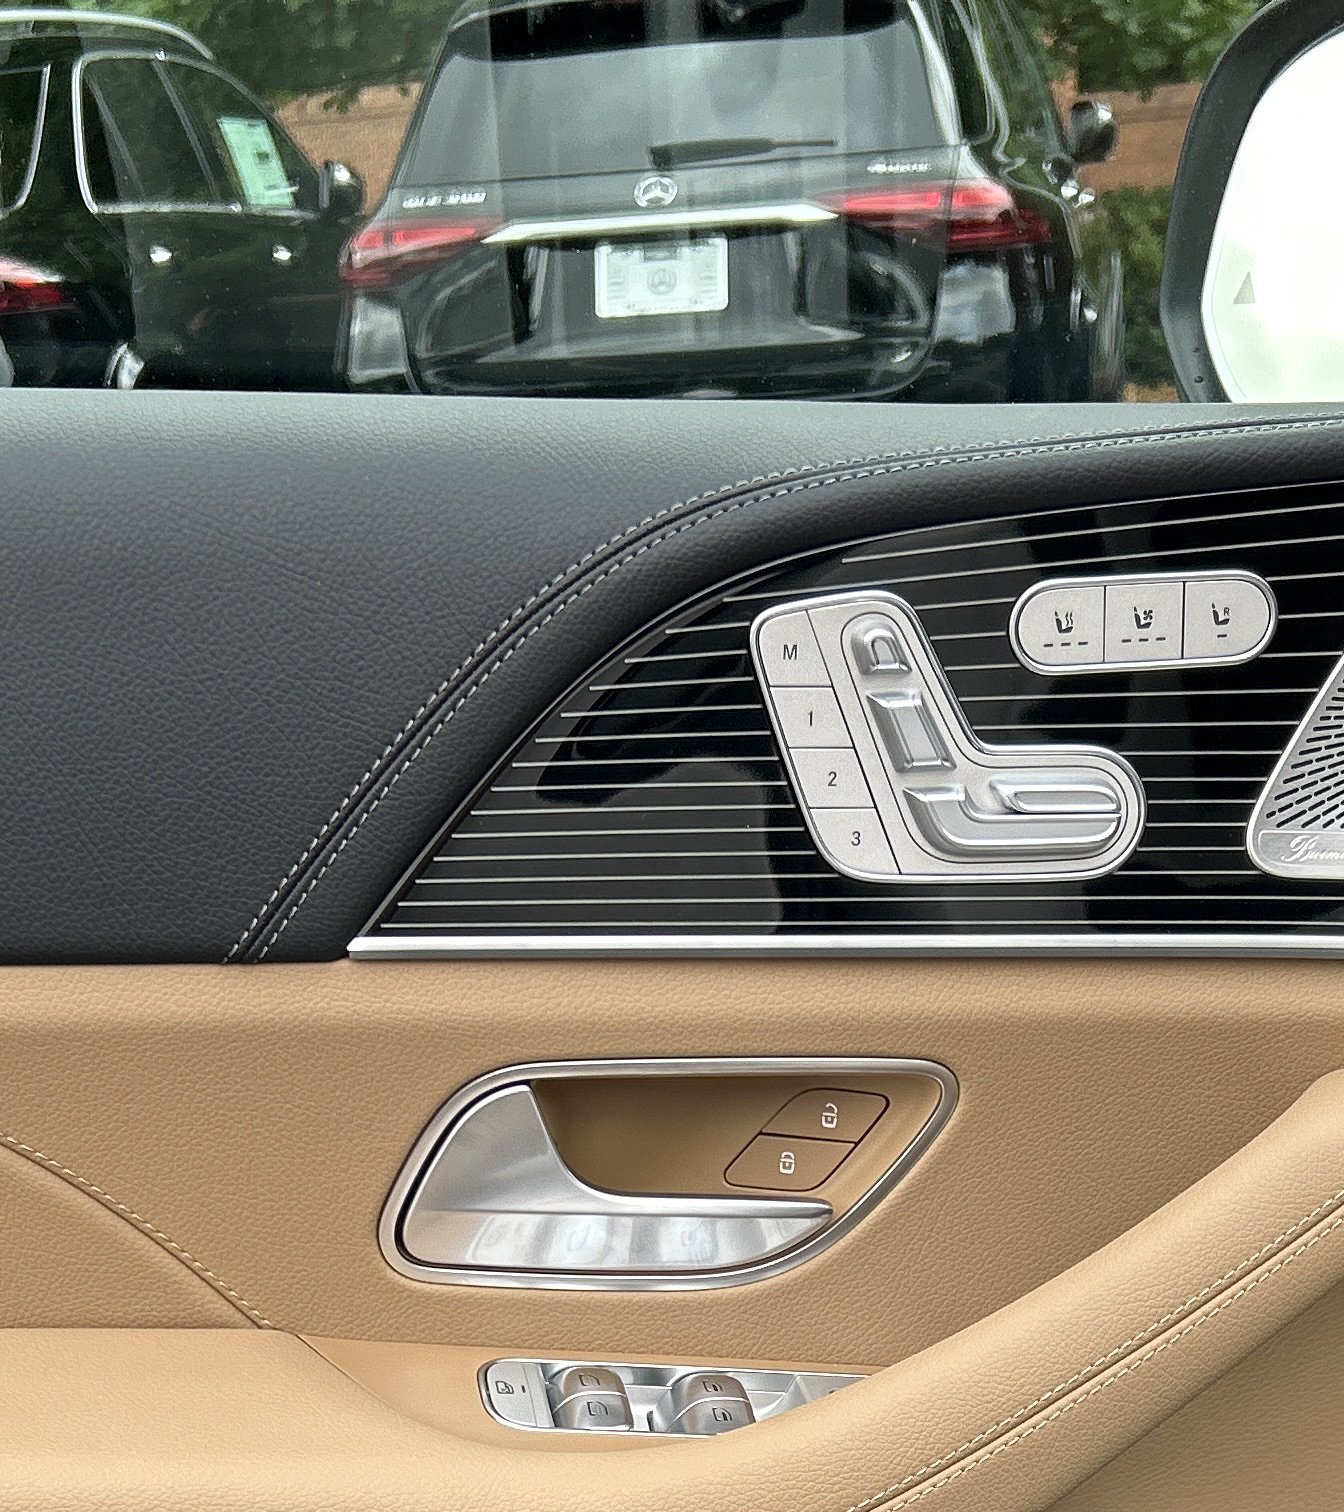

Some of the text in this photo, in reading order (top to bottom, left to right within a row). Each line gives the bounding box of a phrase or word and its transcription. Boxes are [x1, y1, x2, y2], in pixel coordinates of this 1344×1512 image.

[782, 643, 798, 661] M
[807, 710, 814, 727] 1
[827, 771, 838, 787] 2
[850, 831, 862, 847] 3
